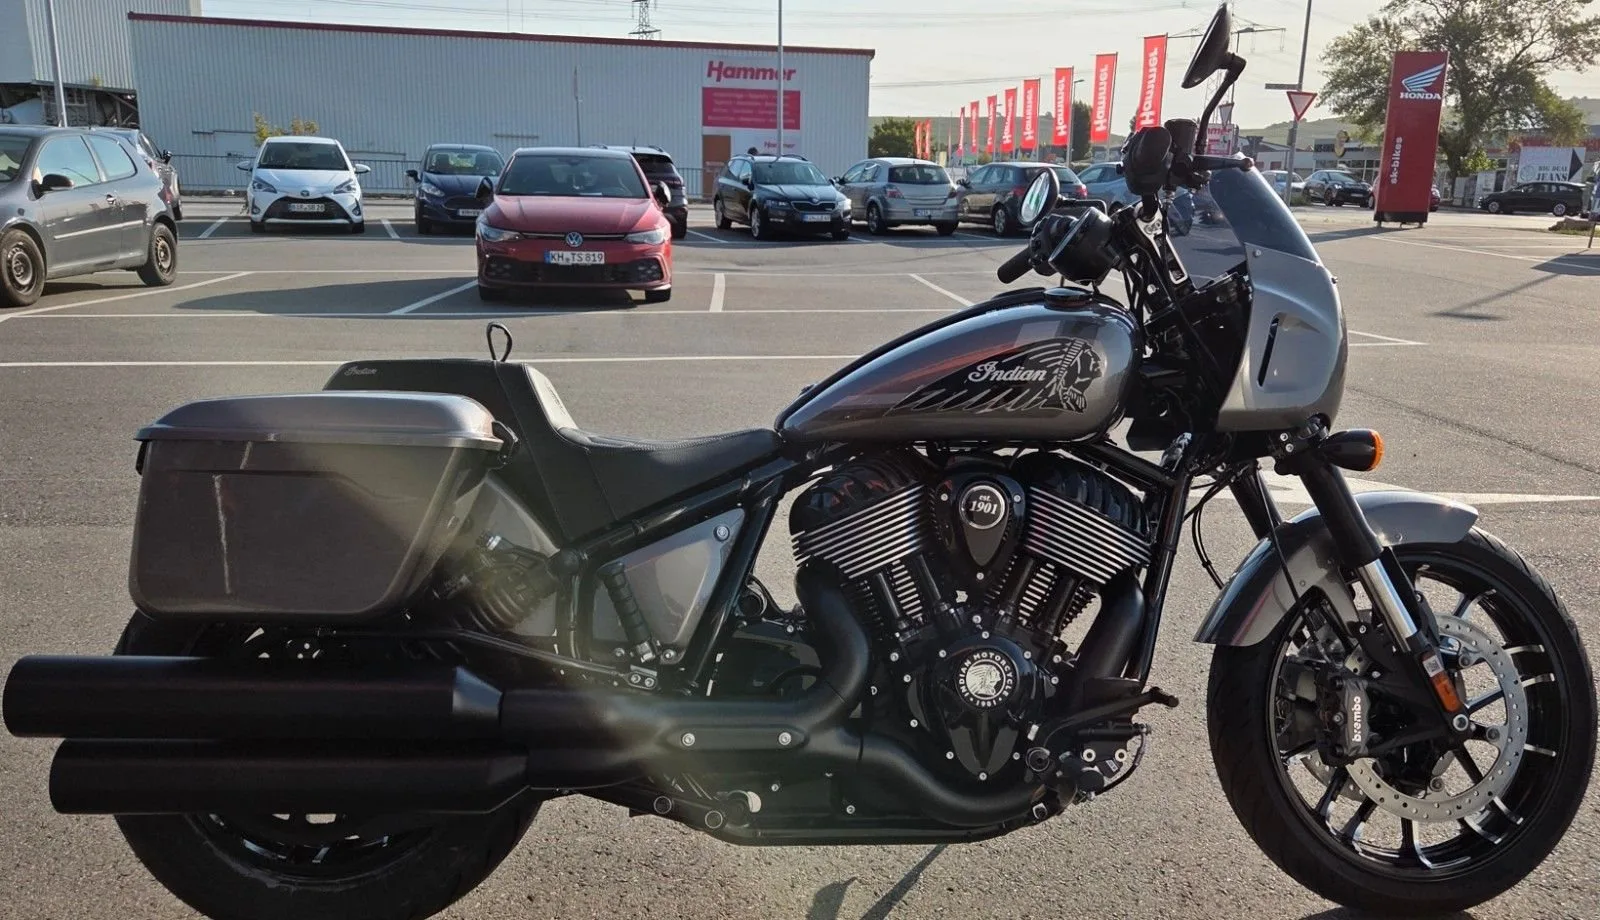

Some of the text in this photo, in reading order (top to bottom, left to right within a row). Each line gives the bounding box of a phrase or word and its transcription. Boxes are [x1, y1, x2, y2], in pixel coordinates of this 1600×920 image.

[1055, 76, 1067, 136] Hammer
[1094, 64, 1109, 131] Hammer
[1140, 47, 1158, 125] Hammer
[1400, 92, 1442, 100] HONDA
[1390, 136, 1403, 185] sk-bikes
[1536, 172, 1568, 181] JEANS
[551, 253, 603, 262] KH TS 819
[967, 361, 1048, 383] Indian
[969, 501, 998, 515] 1901
[958, 659, 972, 697] INDIAN
[972, 651, 1014, 697] MOTORCYCLE
[1351, 695, 1362, 742] brembo
